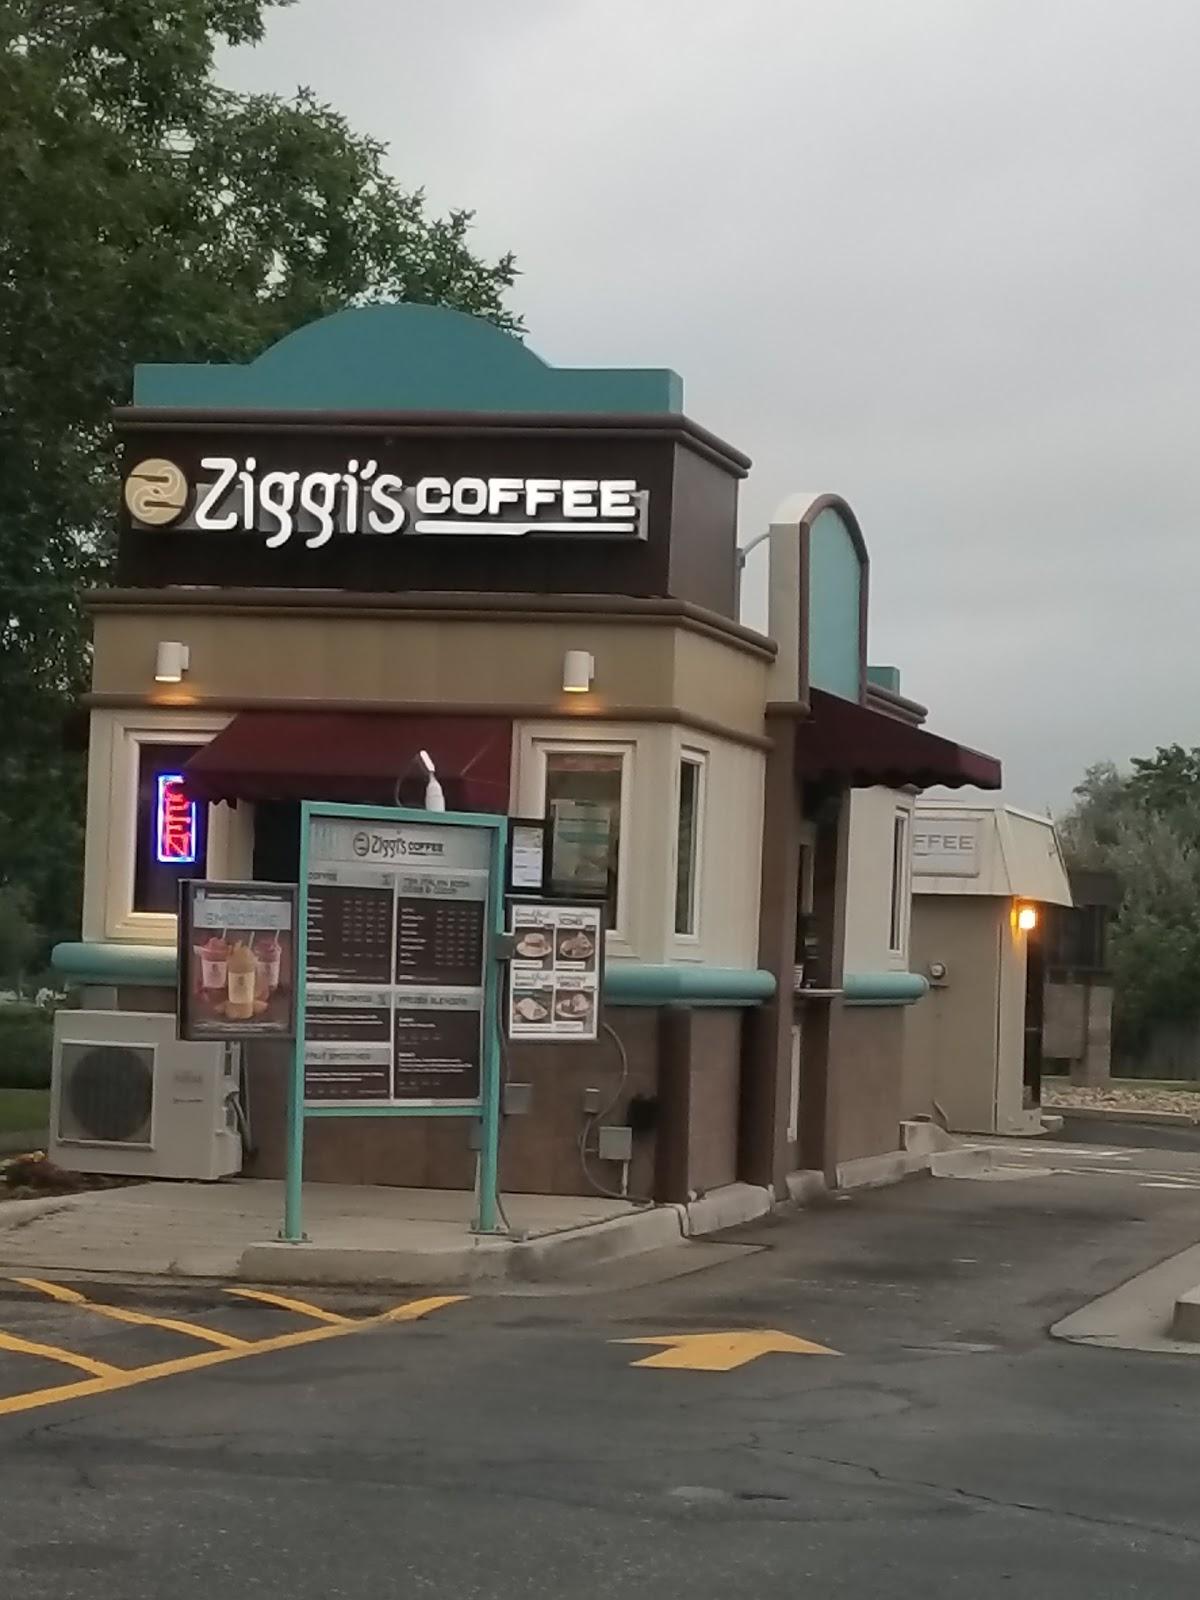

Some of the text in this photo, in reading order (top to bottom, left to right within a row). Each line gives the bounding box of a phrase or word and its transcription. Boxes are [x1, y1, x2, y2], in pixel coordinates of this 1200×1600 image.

[195, 456, 637, 549] Ziggi's COFFEE
[371, 834, 444, 858] Ziggi's COFFEE
